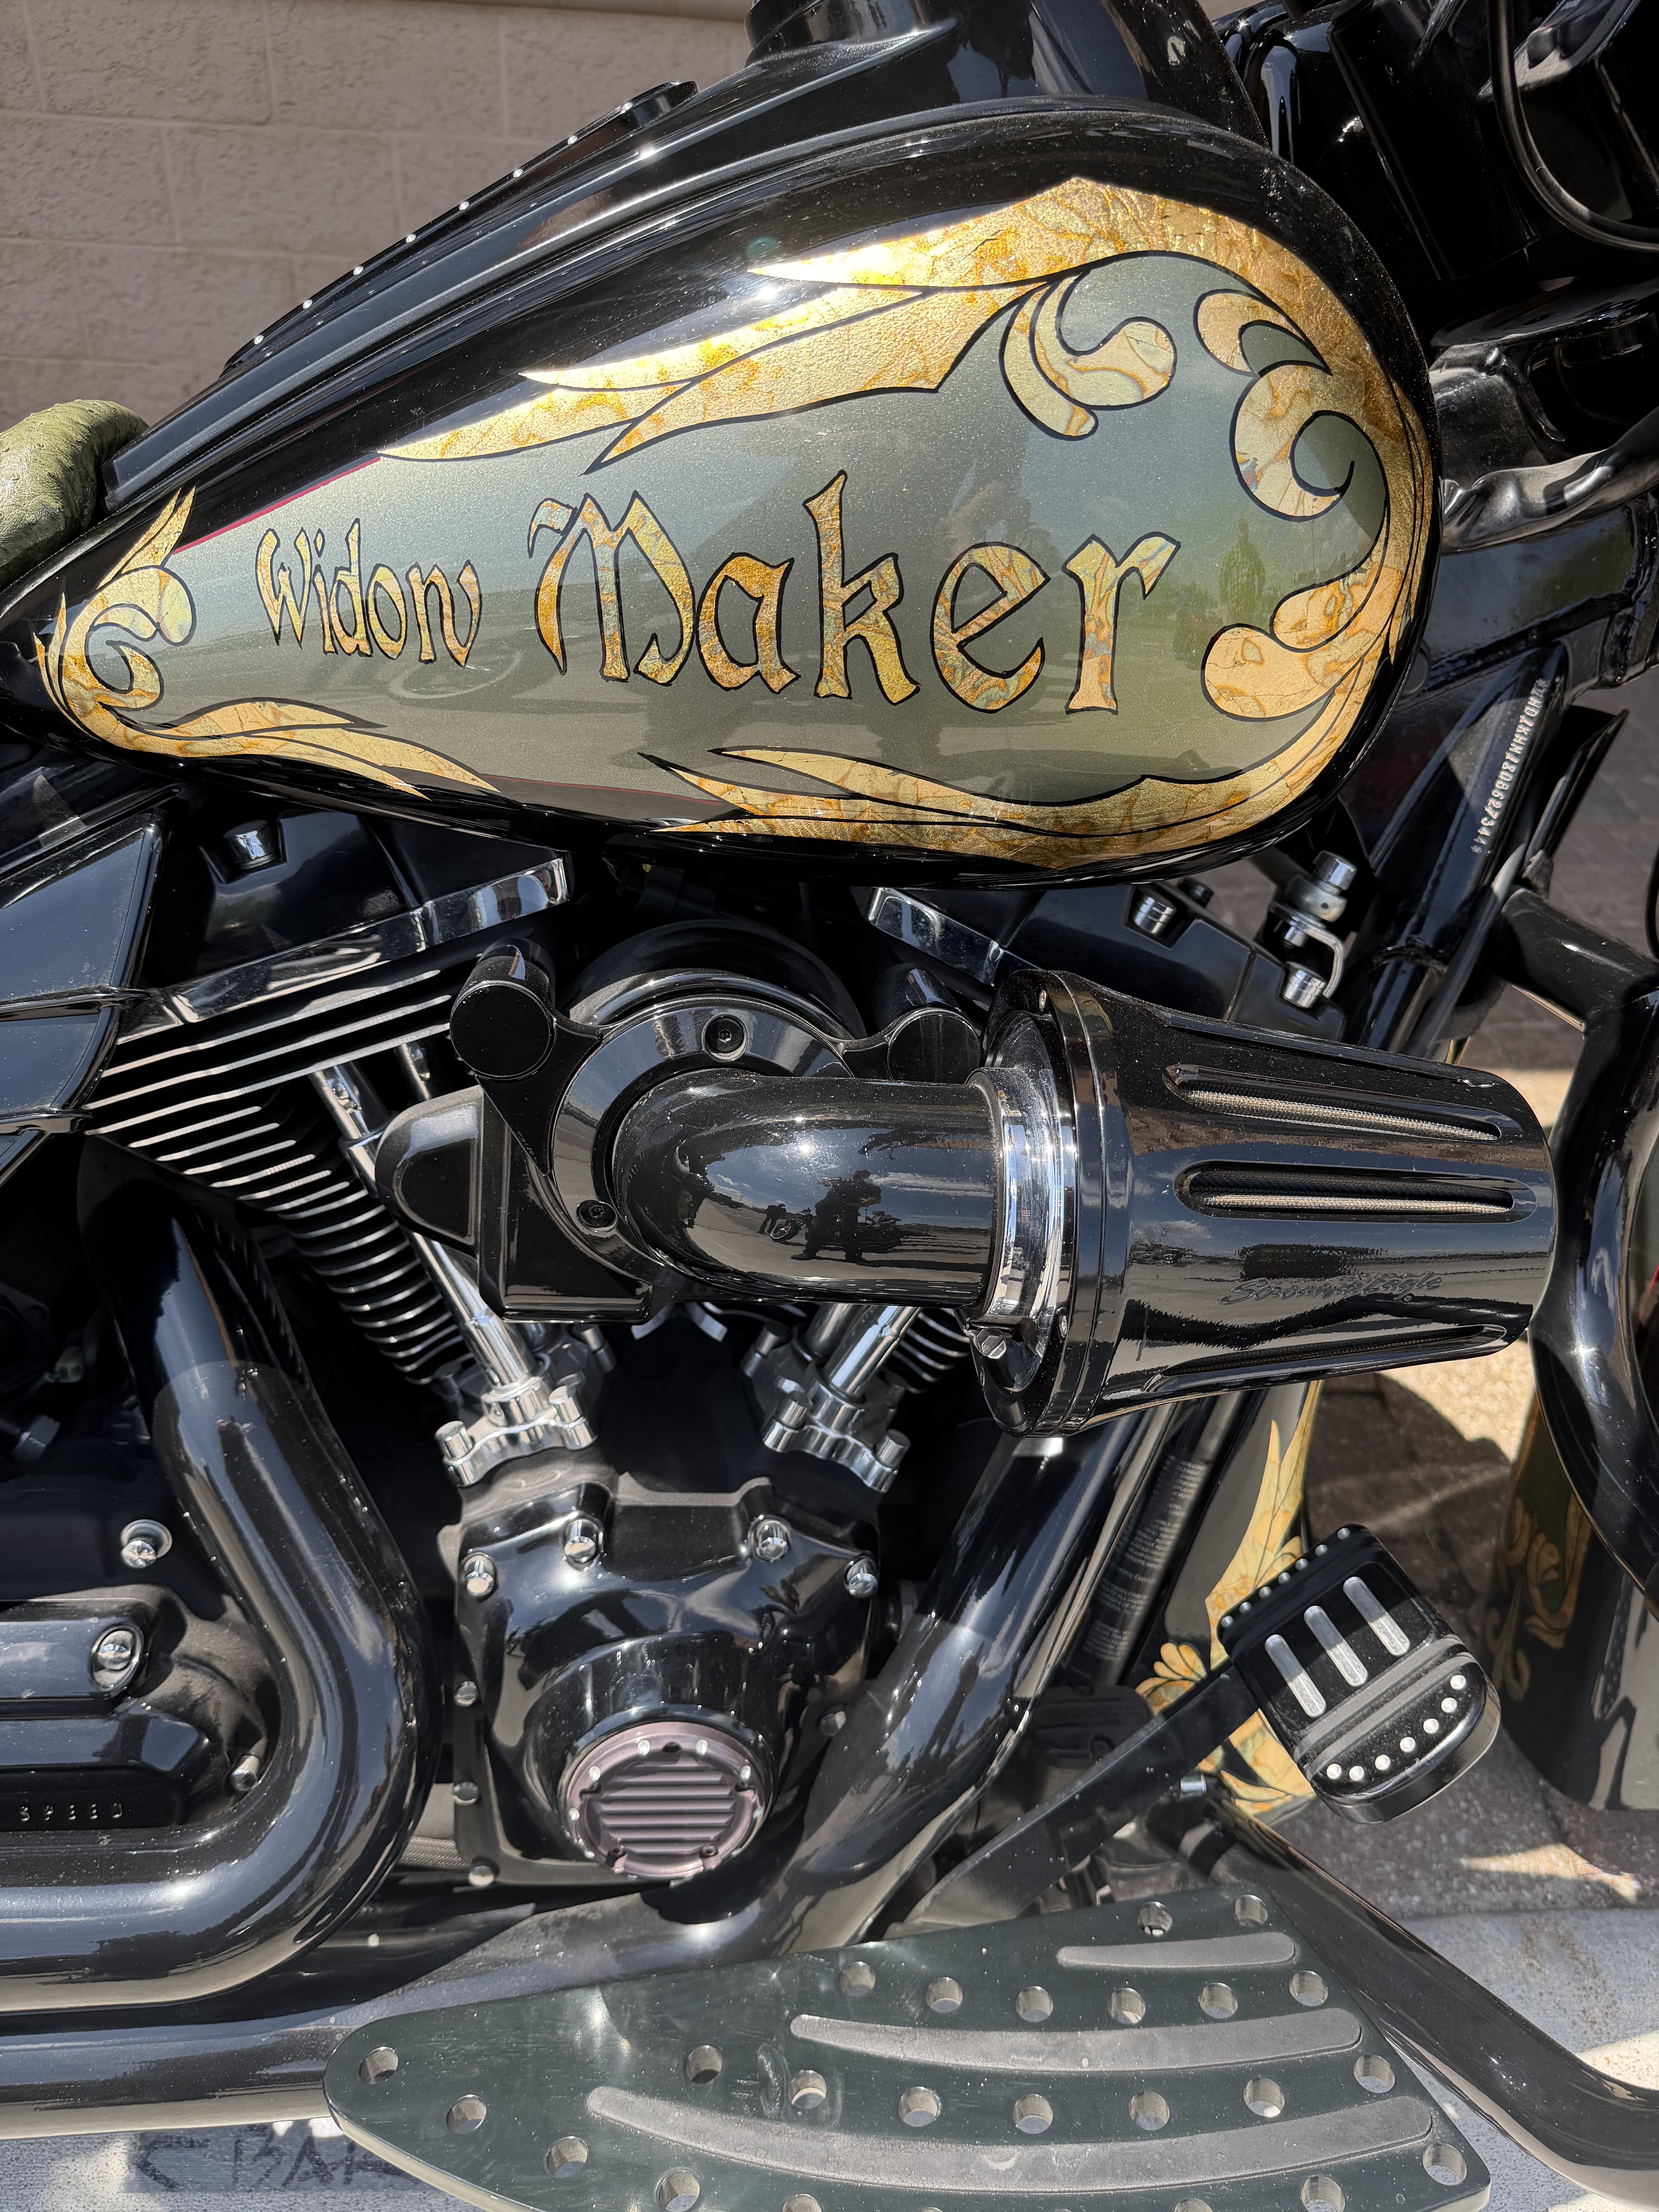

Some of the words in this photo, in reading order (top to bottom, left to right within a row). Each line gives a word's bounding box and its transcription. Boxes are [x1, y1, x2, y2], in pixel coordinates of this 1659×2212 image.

[255, 518, 483, 668] Widow
[527, 470, 1181, 715] Maker
[1361, 1271, 1441, 1300] Eagle
[19, 1803, 122, 1822] SPEED
